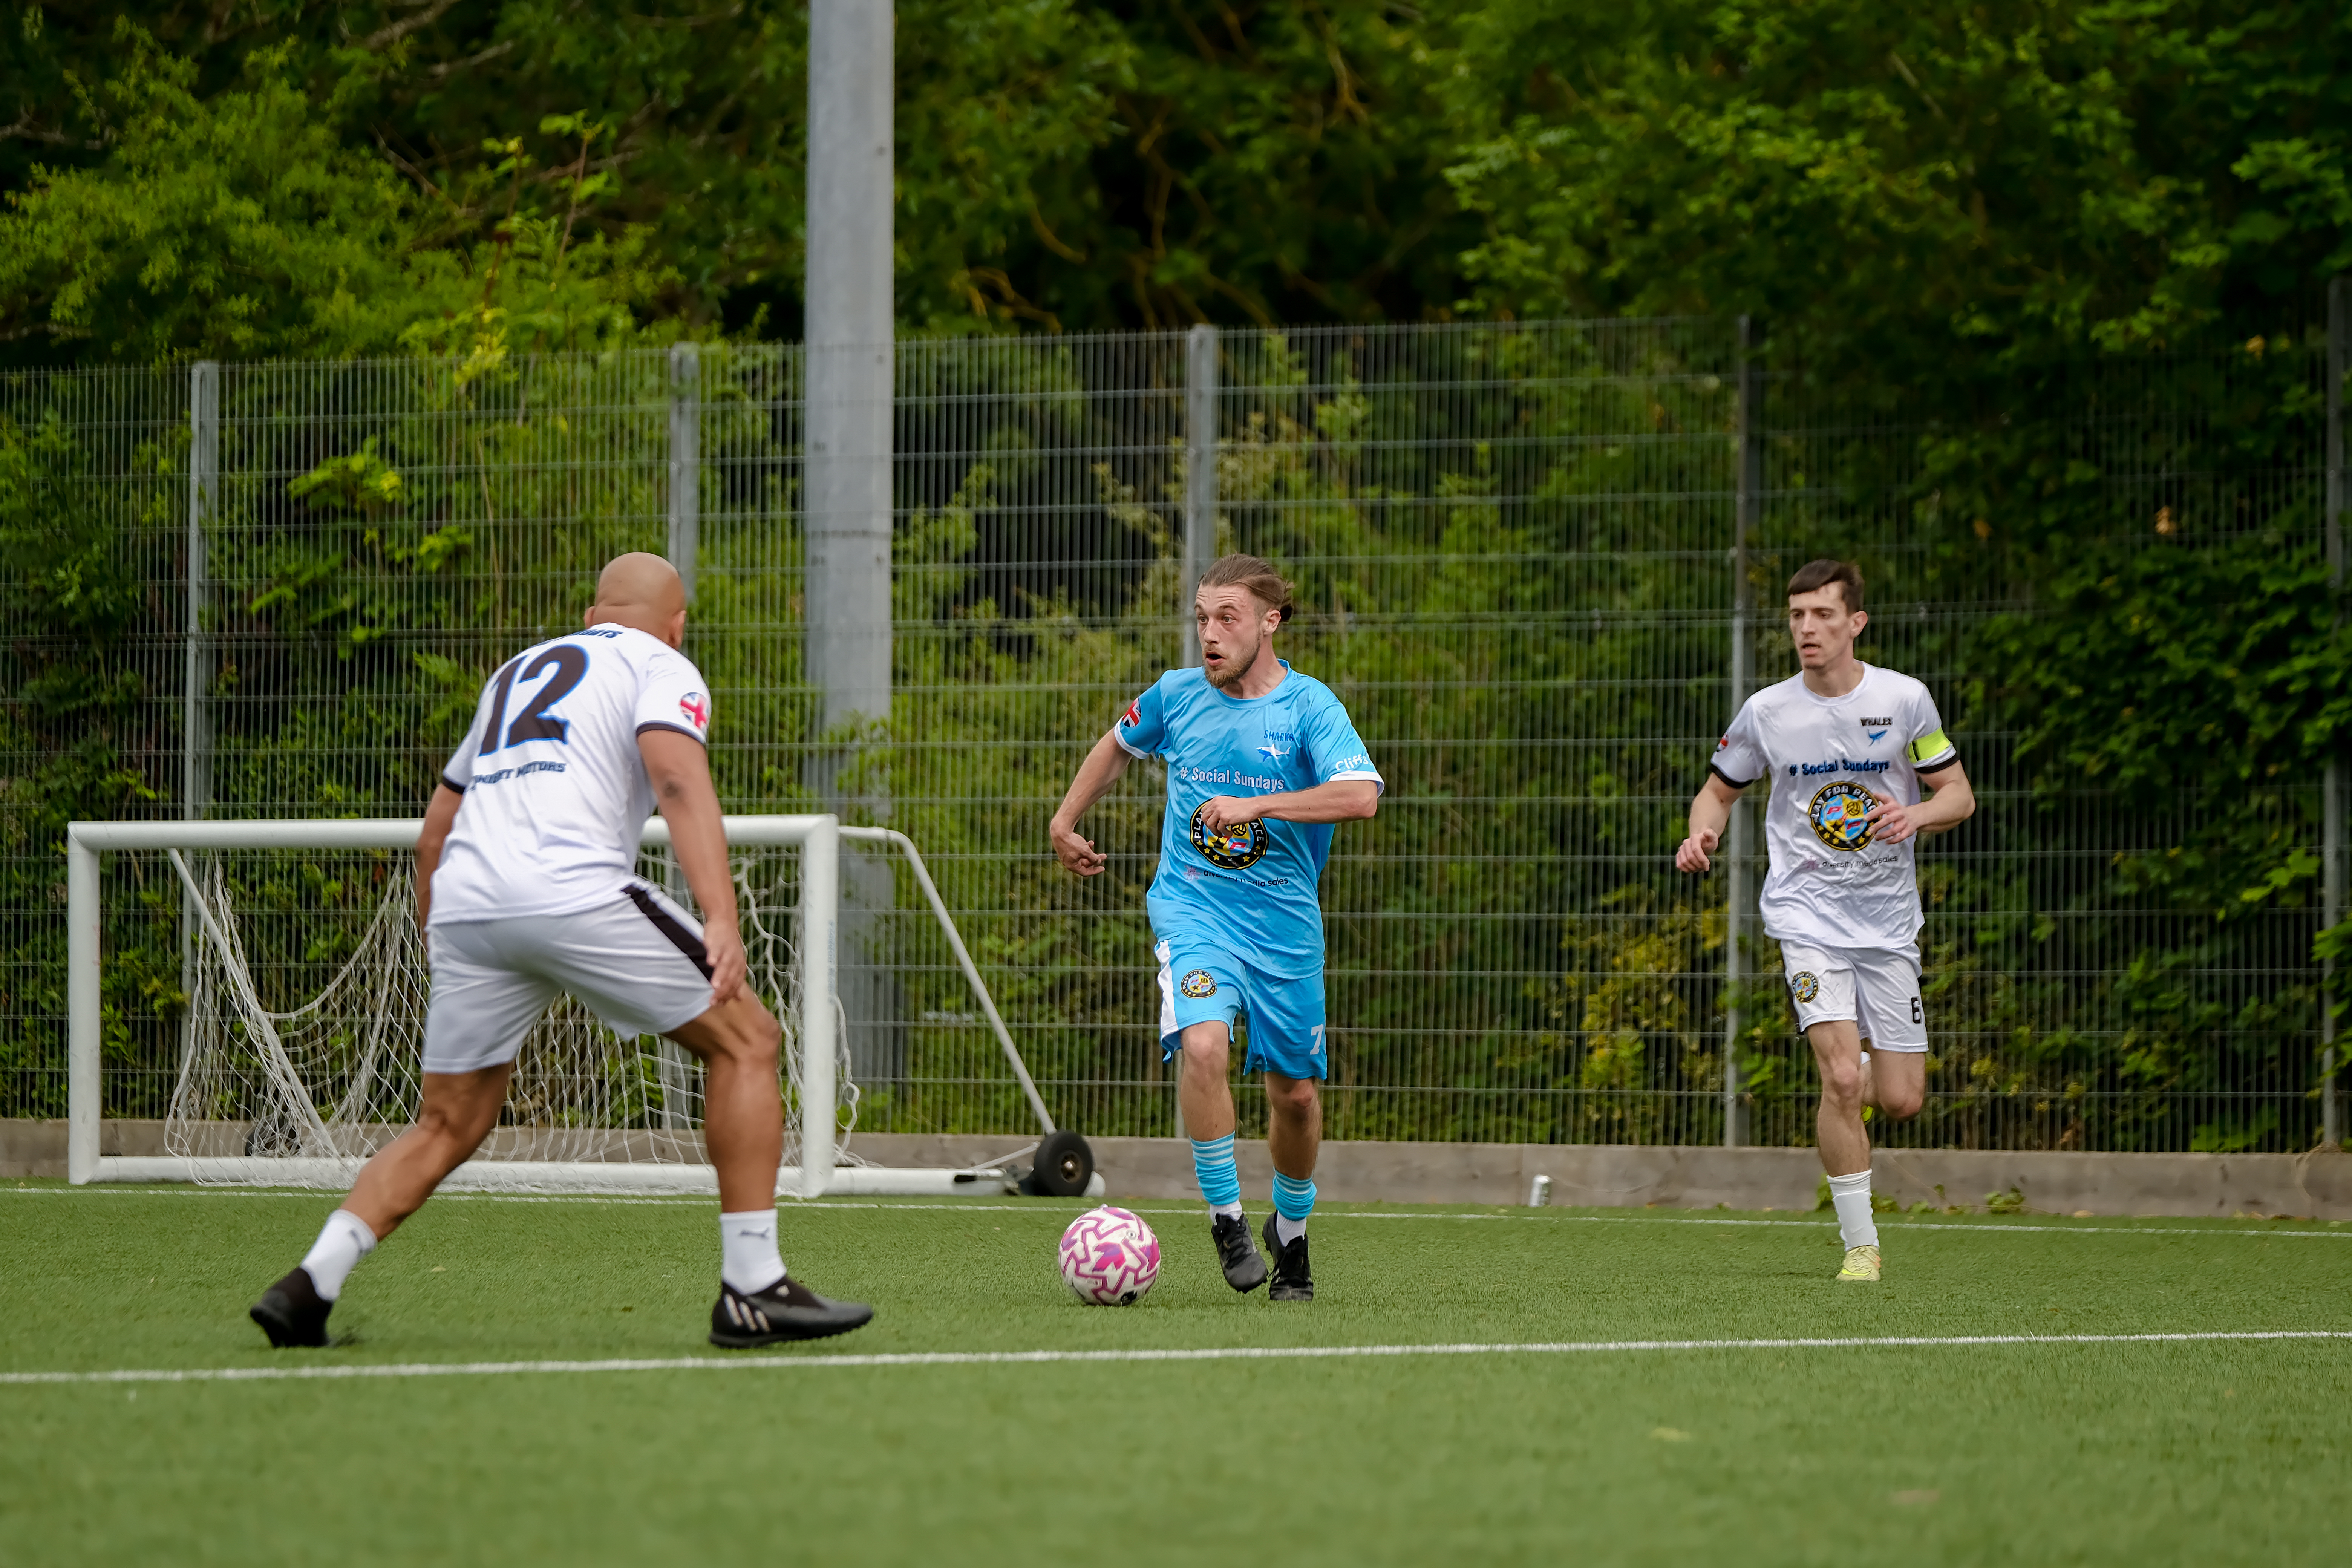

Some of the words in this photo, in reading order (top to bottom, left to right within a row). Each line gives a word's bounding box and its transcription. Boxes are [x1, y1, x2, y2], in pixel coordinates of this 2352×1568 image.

[478, 643, 590, 757] 12
[1860, 716, 1893, 726] WHALES
[1263, 730, 1294, 742] SHARKS
[1802, 759, 1839, 775] Social
[1842, 758, 1890, 773] Sundays
[1191, 767, 1230, 784] Social
[1233, 770, 1285, 793] Sundays
[1824, 785, 1849, 798] FOR
[1852, 788, 1876, 812] PEAC
[1879, 855, 1898, 864] sales
[1268, 877, 1289, 886] sales
[1309, 1024, 1323, 1055] 7
